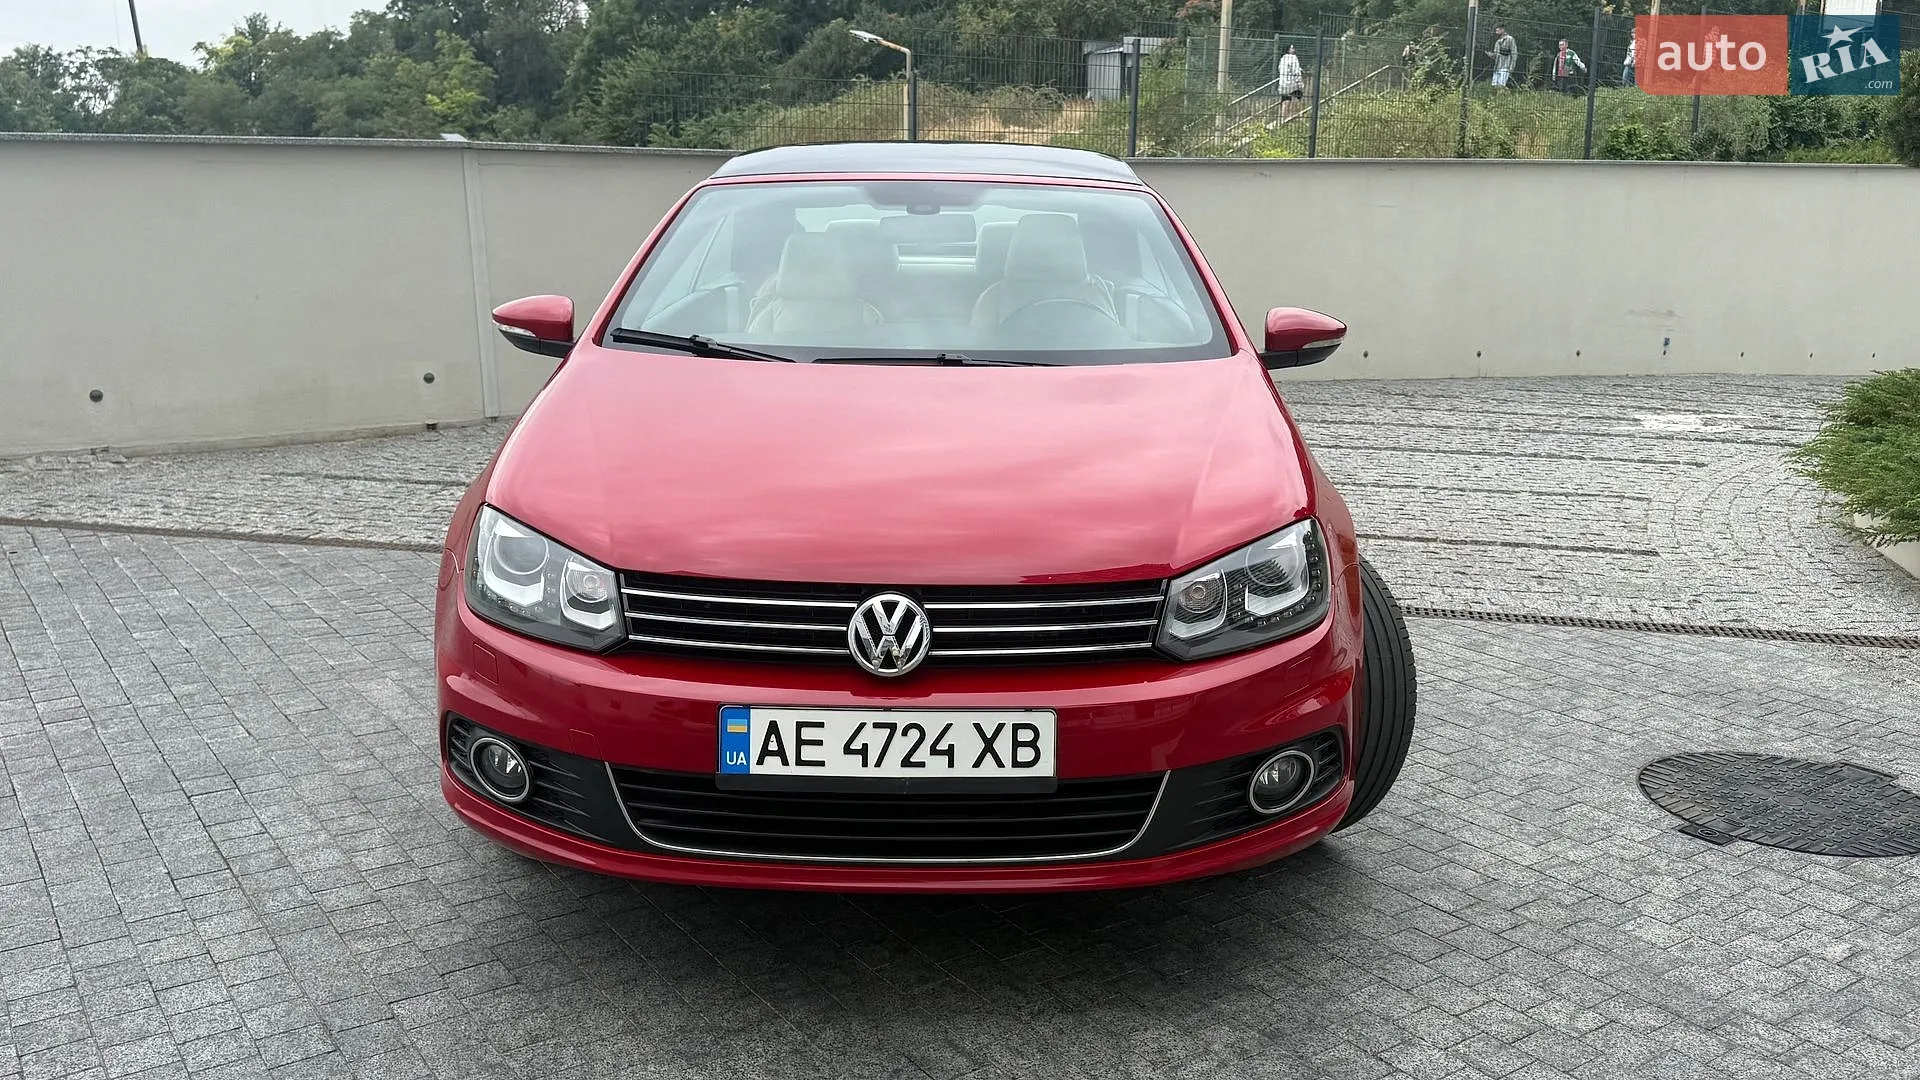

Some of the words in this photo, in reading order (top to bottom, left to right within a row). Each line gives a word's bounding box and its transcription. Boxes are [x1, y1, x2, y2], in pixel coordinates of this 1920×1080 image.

[726, 751, 747, 766] UA
[756, 720, 826, 767] AE
[843, 722, 955, 768] 4724
[971, 722, 1041, 769] XB
